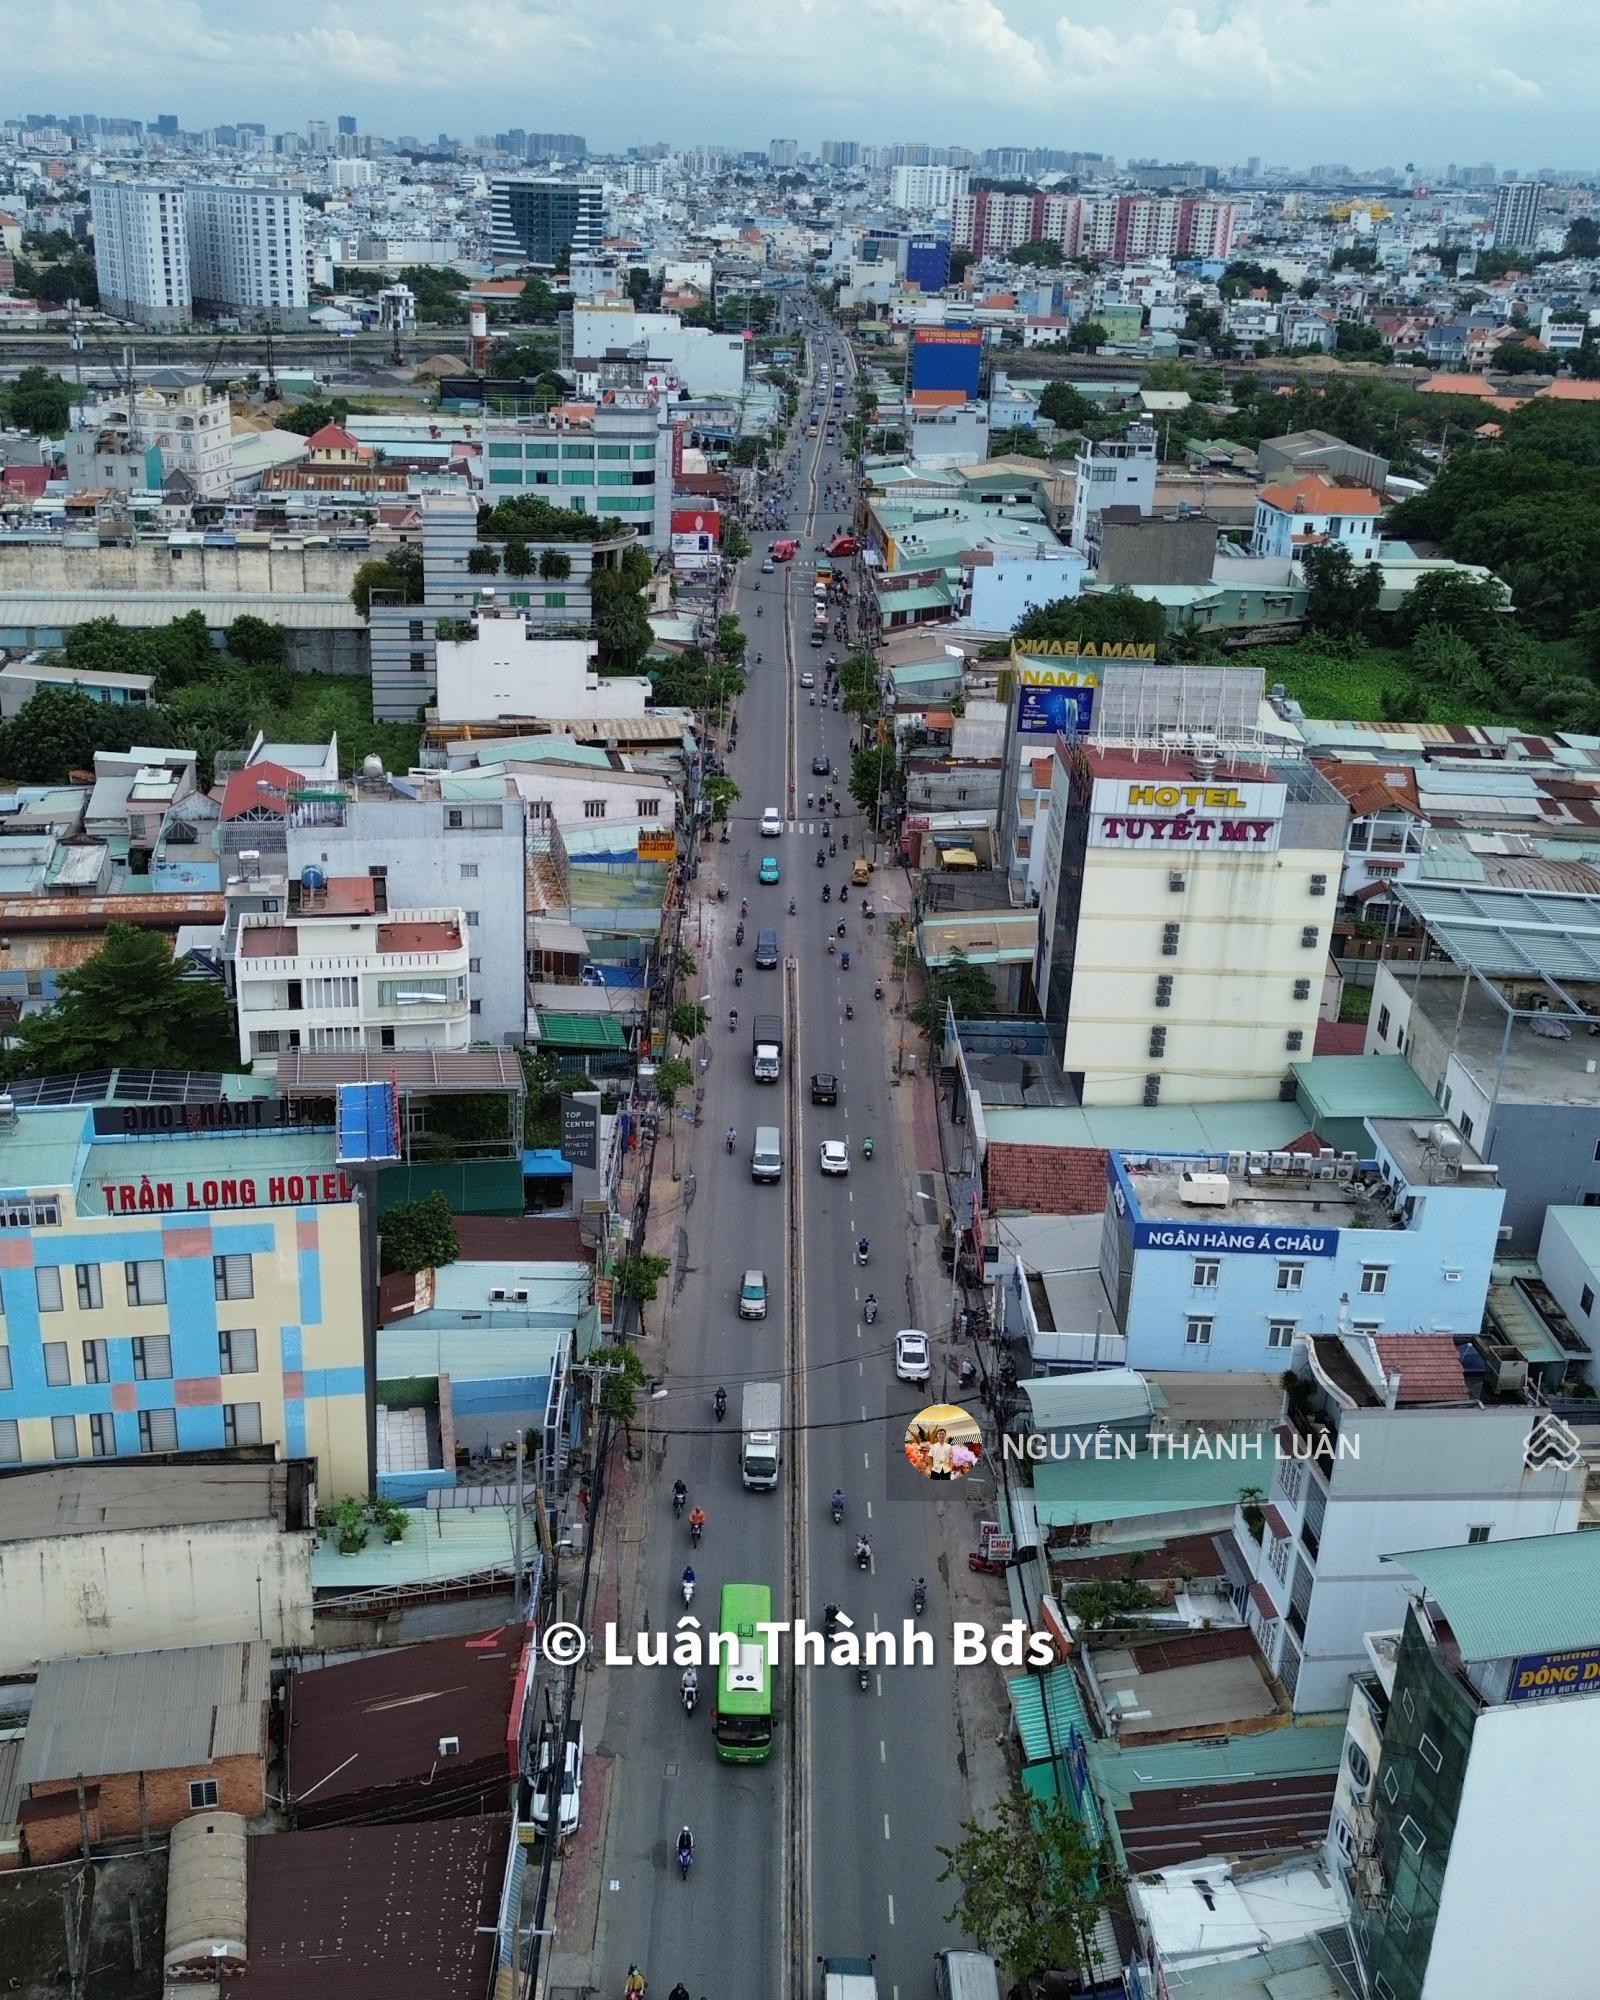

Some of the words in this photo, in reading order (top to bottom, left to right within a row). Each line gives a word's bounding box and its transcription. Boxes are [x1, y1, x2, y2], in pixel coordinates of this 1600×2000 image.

[1022, 670, 1078, 687] NAM
[1128, 785, 1247, 808] HOTEL
[1102, 809, 1216, 842] TUYẾT
[1219, 821, 1275, 843] MY
[103, 1174, 174, 1210] TRẦN
[187, 1179, 256, 1207] LONG
[269, 1173, 352, 1202] HOTEL
[1148, 1229, 1201, 1247] NGÂN
[1203, 1231, 1255, 1249] HÀNG
[1258, 1233, 1271, 1249] Á
[1274, 1234, 1325, 1251] CHÂU
[1519, 1665, 1578, 1688] ĐÔNG
